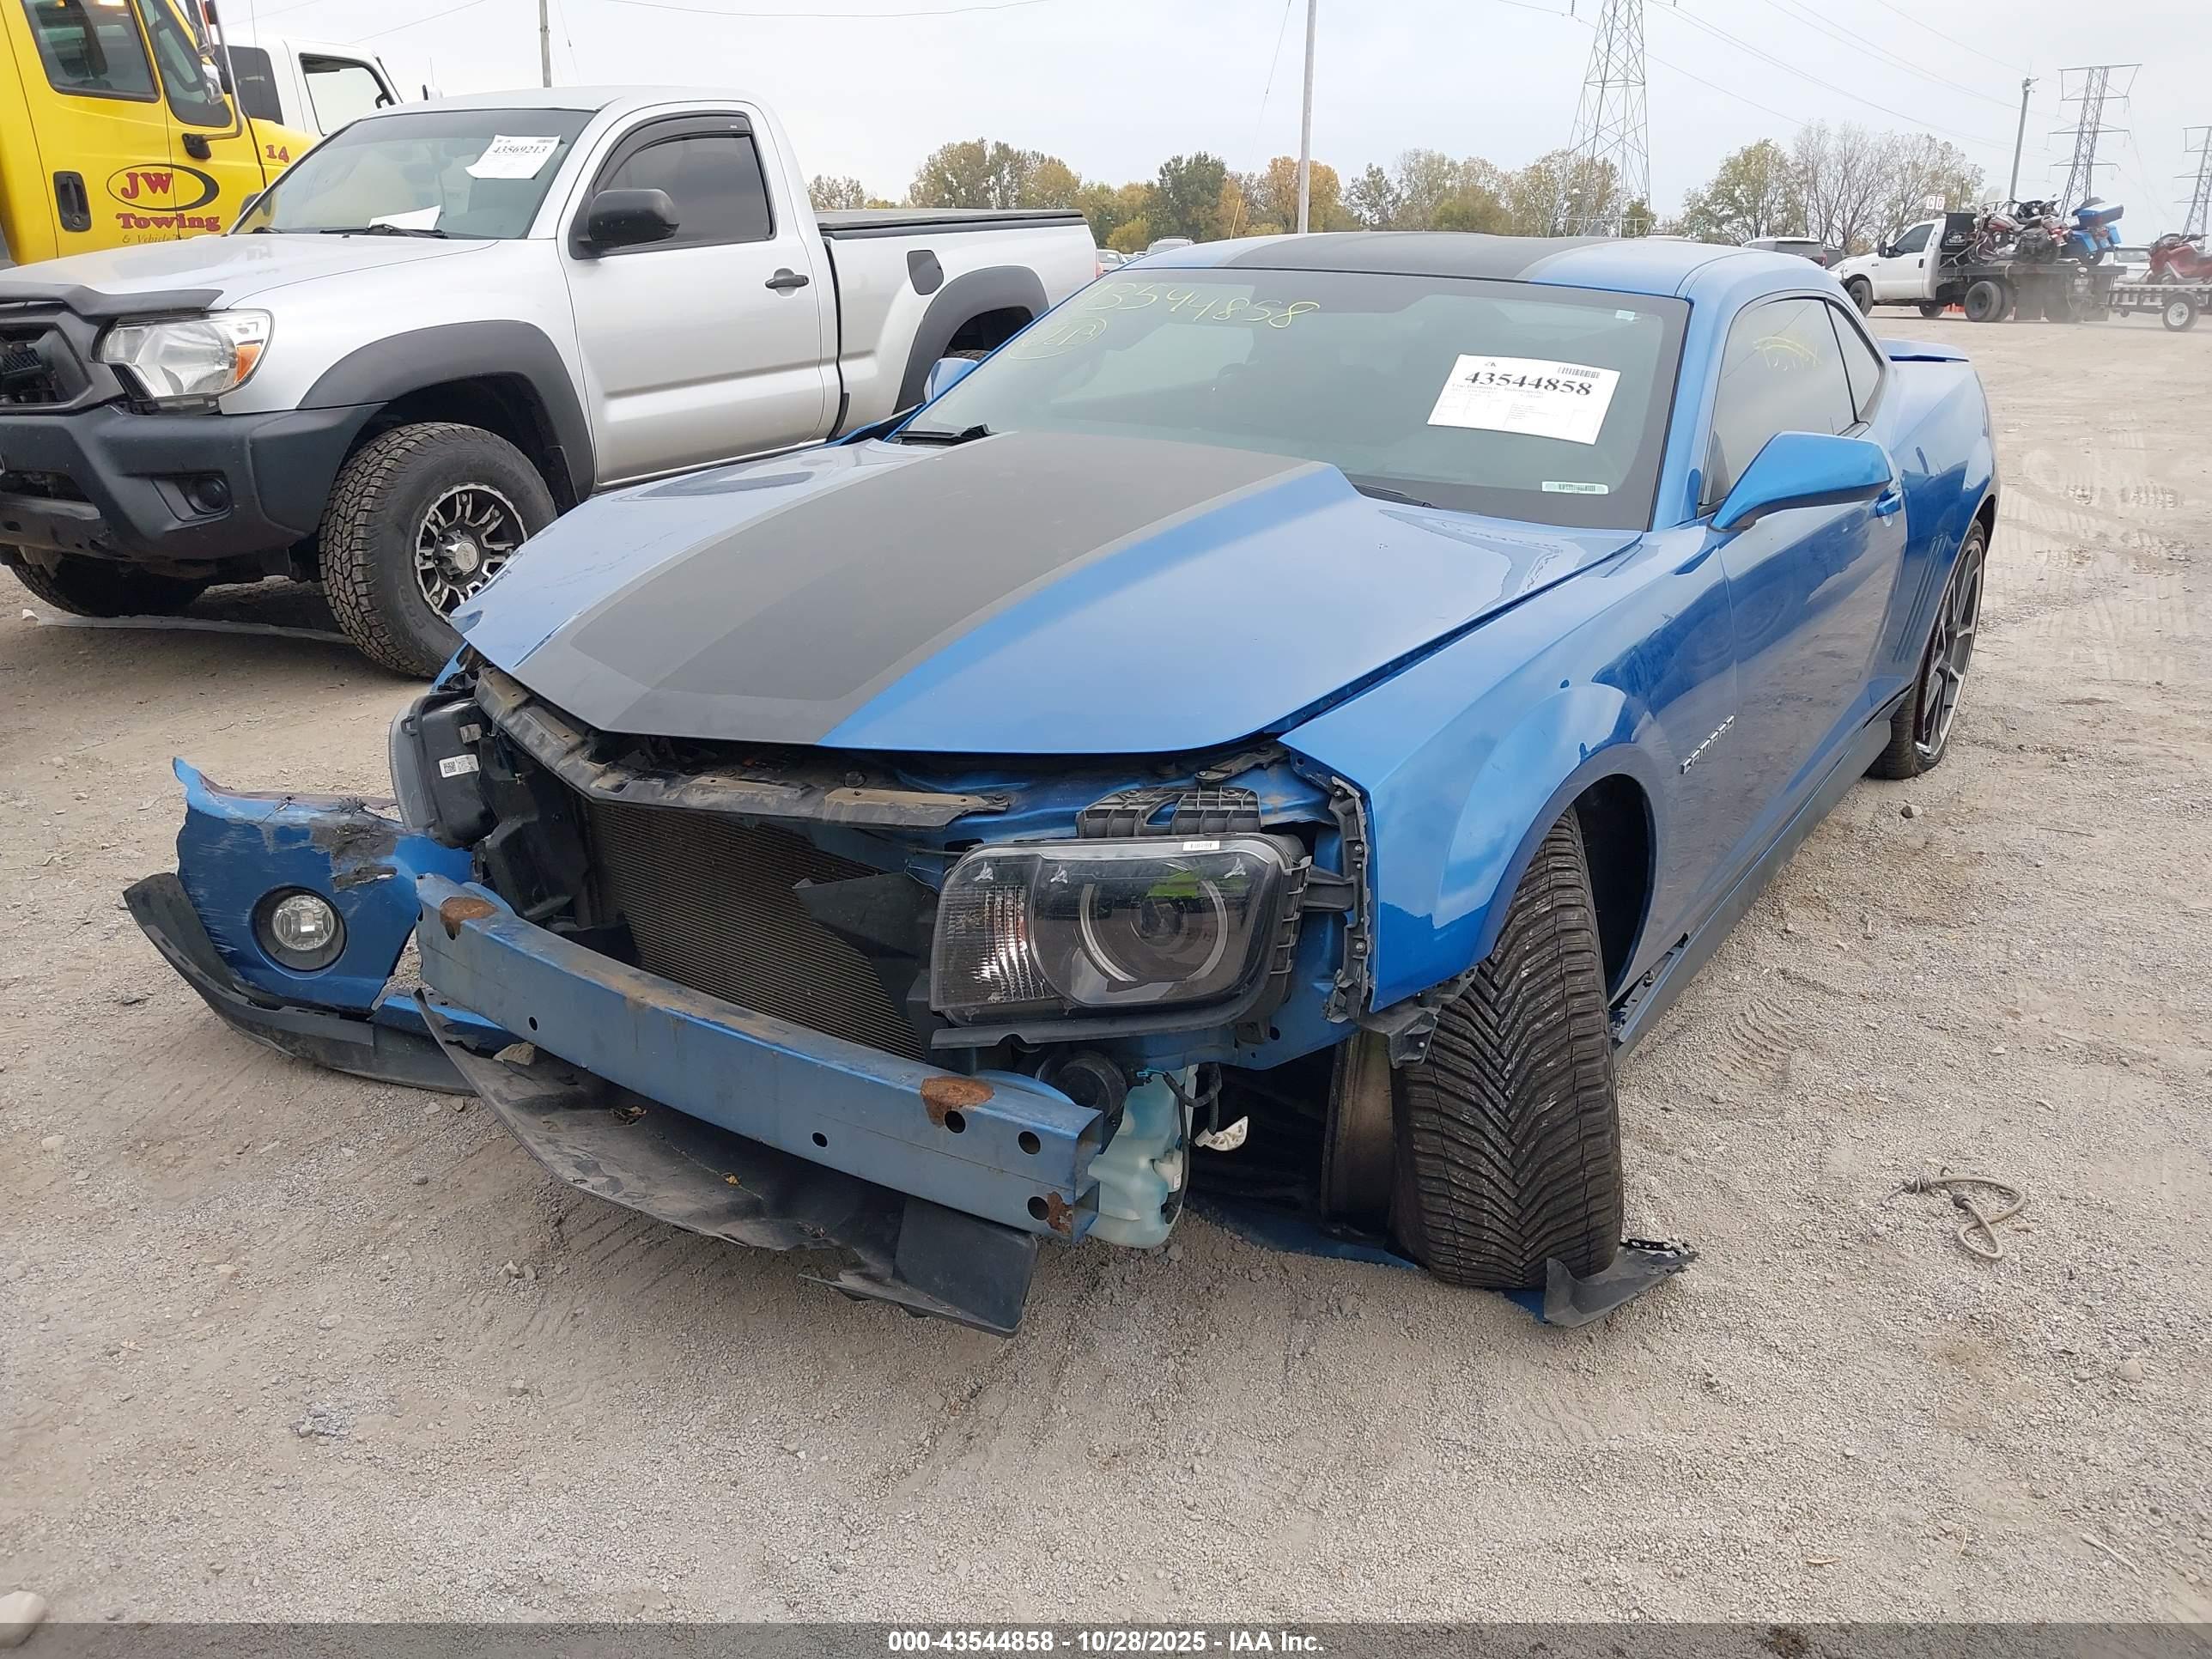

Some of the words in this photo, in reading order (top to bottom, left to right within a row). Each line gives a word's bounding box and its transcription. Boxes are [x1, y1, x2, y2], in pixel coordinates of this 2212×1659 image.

[265, 144, 290, 163] 14
[120, 172, 173, 200] JW
[116, 212, 222, 232] Towing
[1464, 371, 1594, 397] 43544858
[1680, 714, 1735, 775] CAMARO
